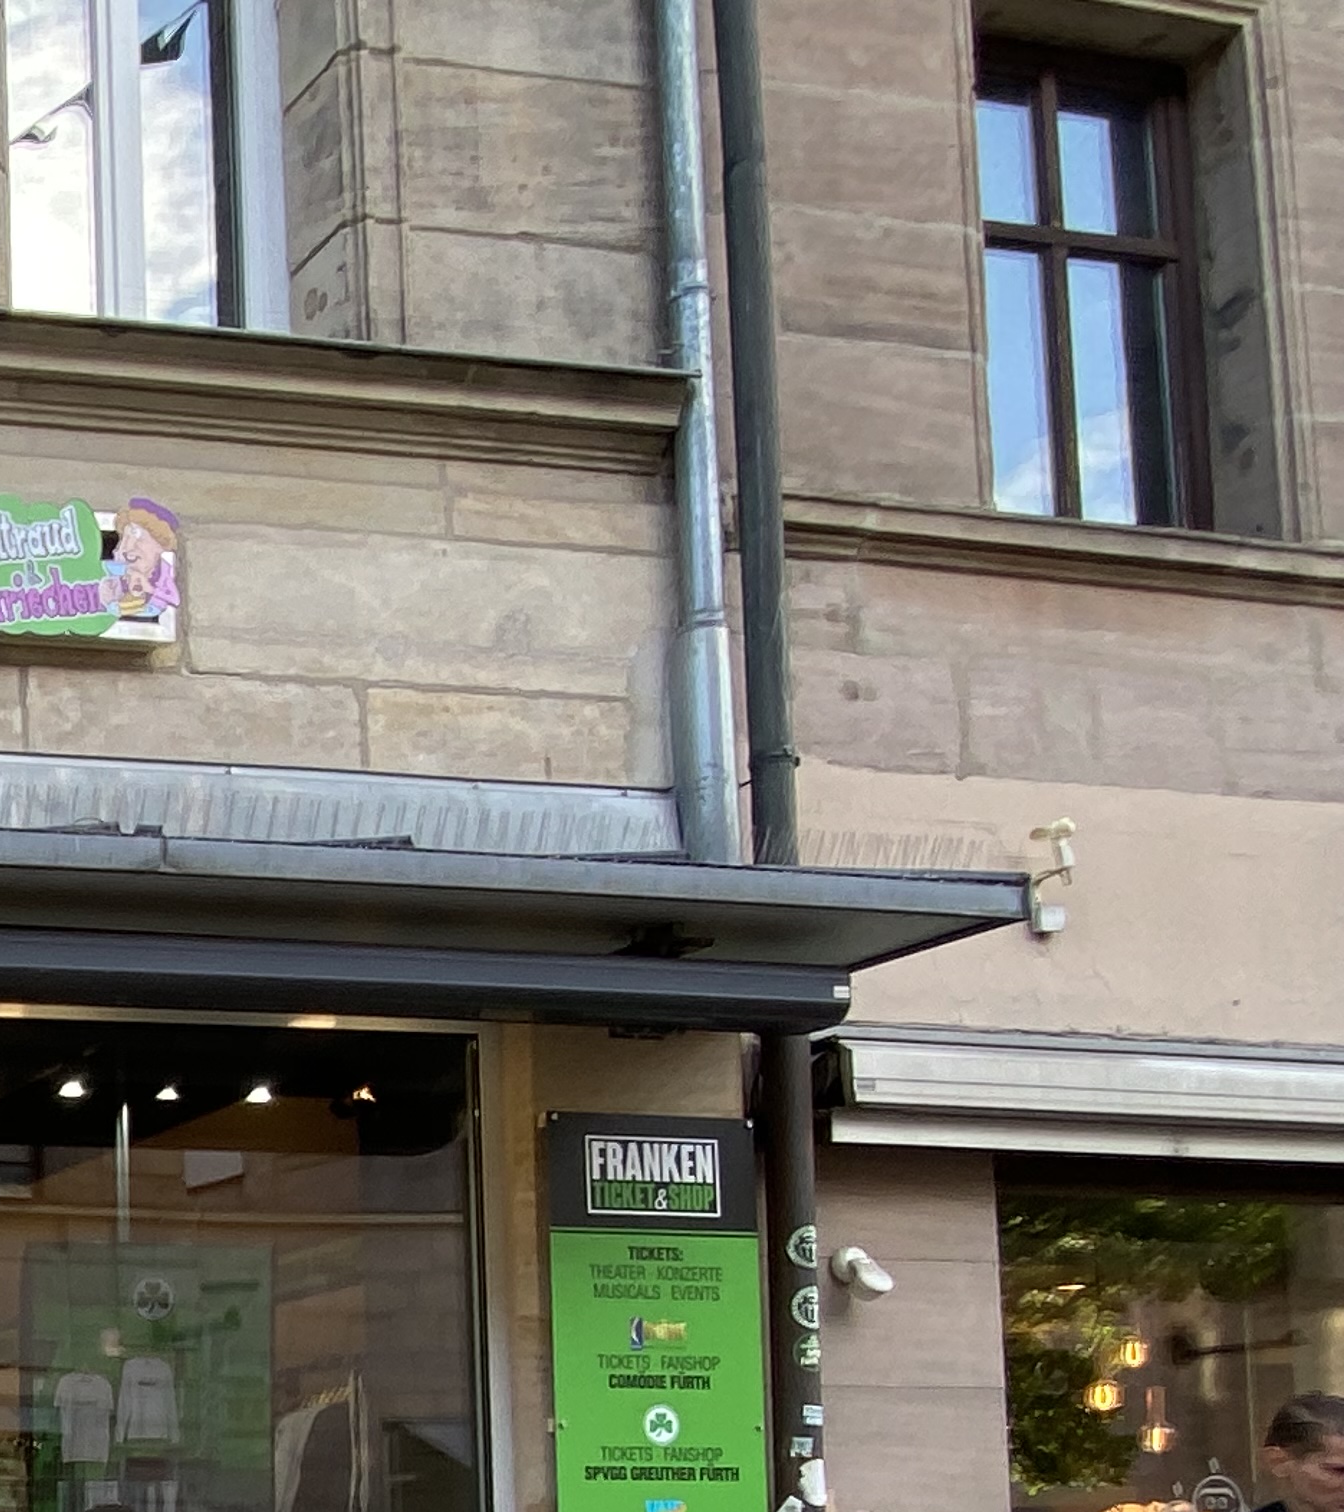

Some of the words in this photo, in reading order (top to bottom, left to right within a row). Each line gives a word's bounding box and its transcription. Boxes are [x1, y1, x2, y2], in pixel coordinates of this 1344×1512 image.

[591, 1140, 713, 1184] FRANKEN
[592, 1181, 714, 1211] TICKET&SHOP
[628, 1246, 683, 1262] TICKETS:
[589, 1264, 646, 1281] THEATER
[656, 1265, 723, 1283] KONZERTE
[593, 1283, 661, 1300] MUSICALS
[671, 1285, 720, 1302] EVENTS
[597, 1353, 650, 1370] TICKETS
[661, 1355, 721, 1372] FANSHOP
[608, 1370, 667, 1390] COMÖDIE
[670, 1370, 711, 1391] FÜRTH
[600, 1446, 653, 1462] TICKETS
[663, 1447, 723, 1463] FANSHOP
[584, 1466, 628, 1482] SPVGG
[630, 1466, 696, 1482] GREUTHER
[699, 1462, 740, 1482] FÜRTH
